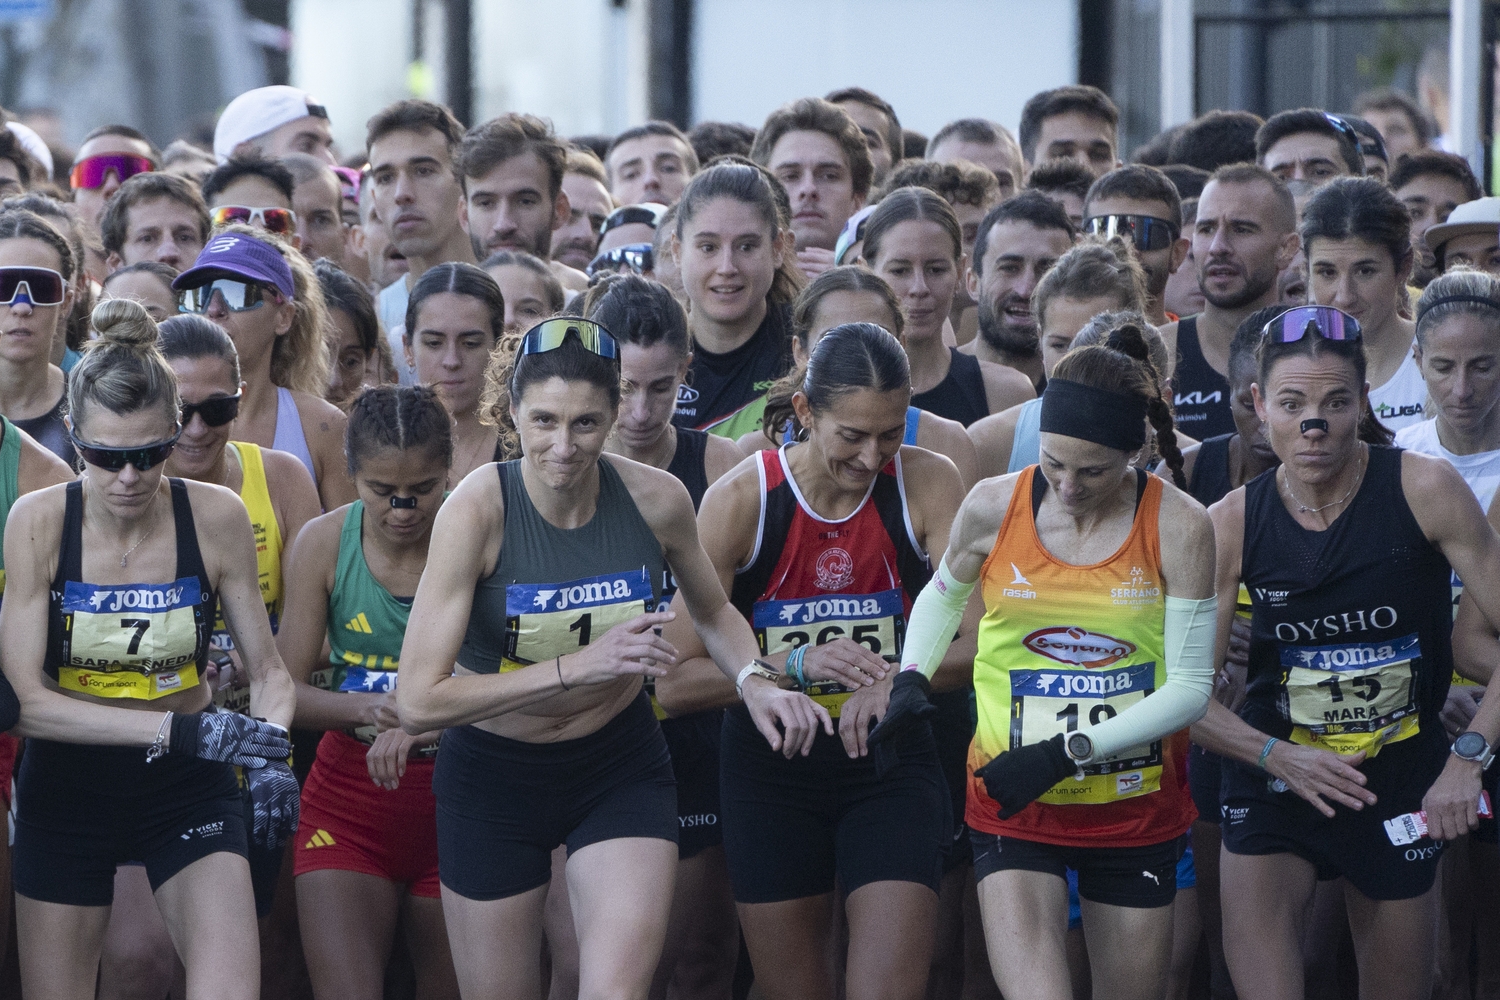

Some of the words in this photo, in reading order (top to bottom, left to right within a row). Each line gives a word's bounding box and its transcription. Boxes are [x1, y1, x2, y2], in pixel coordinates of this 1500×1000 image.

[1110, 587, 1161, 599] SERRANO
[1267, 590, 1290, 598] VICKY
[569, 612, 592, 647] 1
[1275, 606, 1398, 643] OYSHO
[120, 618, 151, 655] 7
[1317, 672, 1383, 703] 15
[1324, 706, 1380, 722] MARA
[1045, 787, 1069, 796] orum
[1070, 787, 1092, 796] sport
[1229, 807, 1250, 815] VICKY
[195, 820, 224, 833] VICKY
